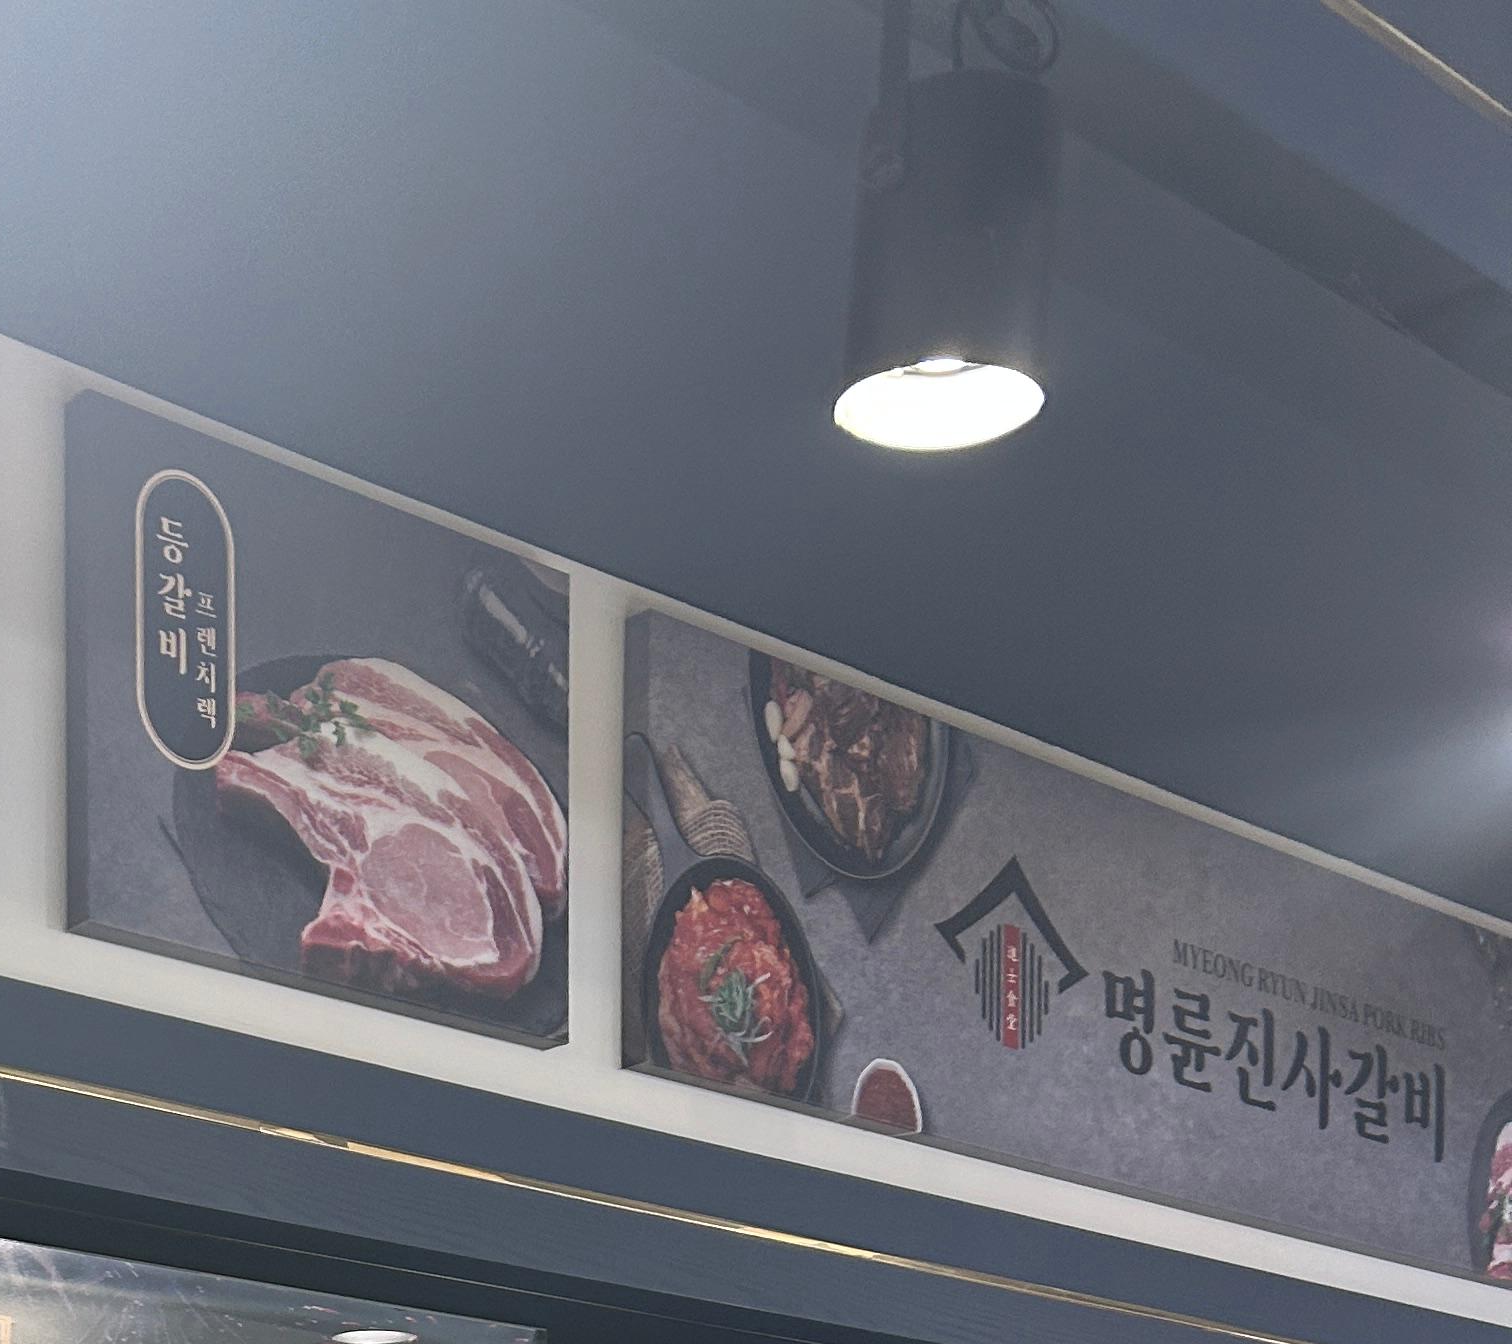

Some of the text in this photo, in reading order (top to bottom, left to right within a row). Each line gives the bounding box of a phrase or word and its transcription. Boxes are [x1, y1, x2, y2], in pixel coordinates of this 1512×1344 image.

[156, 516, 193, 675] 등갈비
[1102, 968, 1445, 1163] 명륜진사갈비
[1173, 939, 1445, 1051] MYEONG RYUN JINSA PORK RIBS
